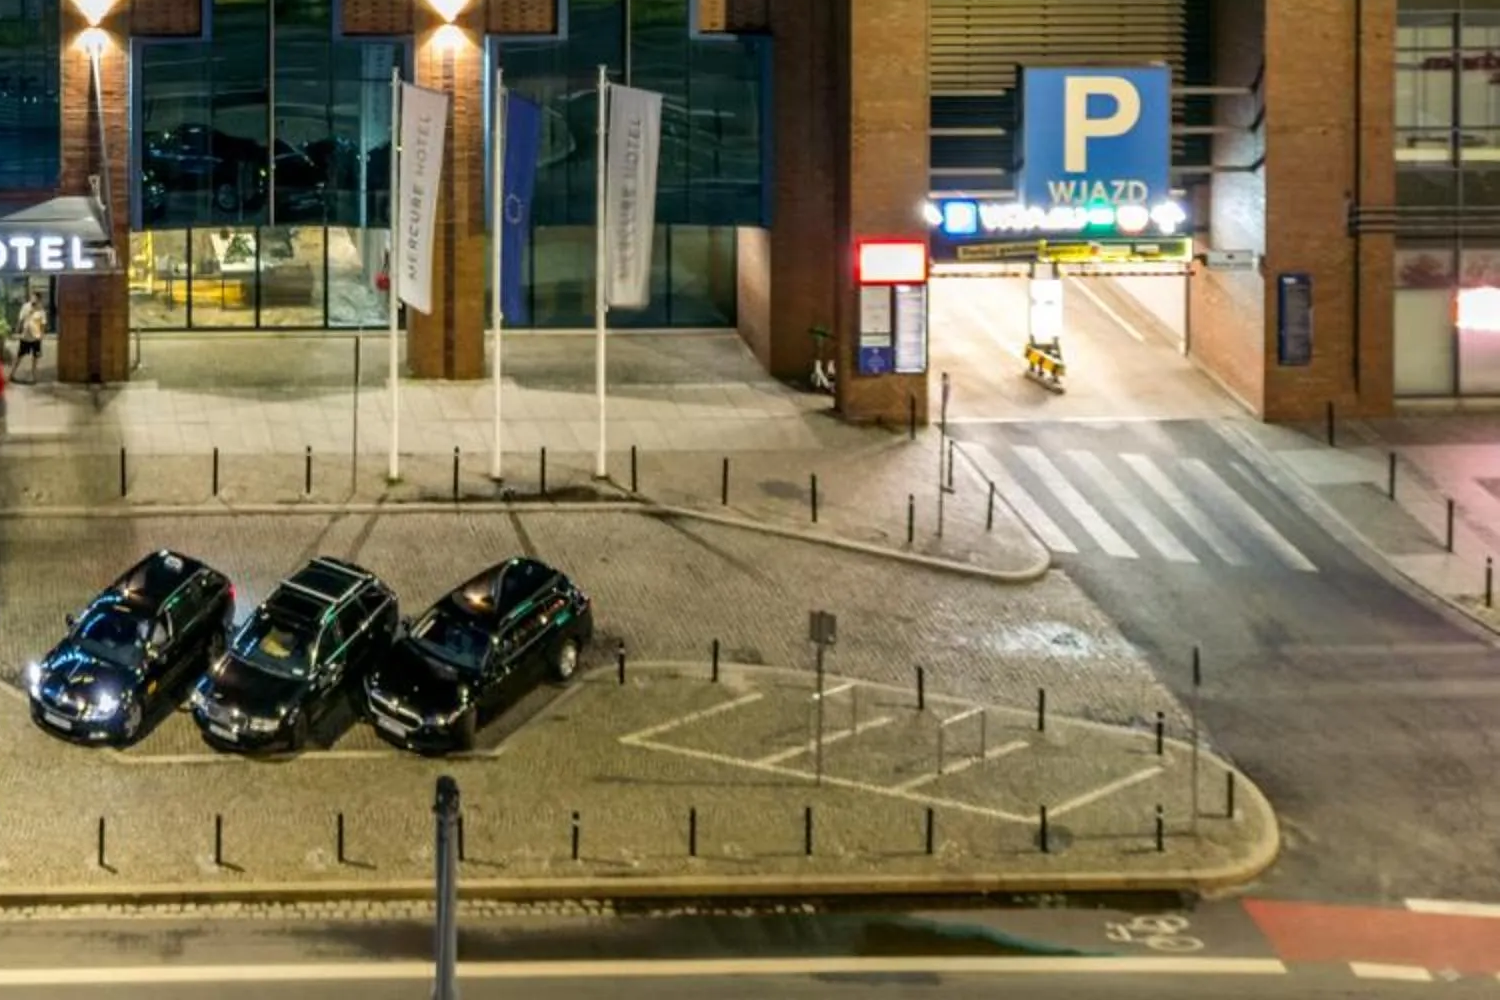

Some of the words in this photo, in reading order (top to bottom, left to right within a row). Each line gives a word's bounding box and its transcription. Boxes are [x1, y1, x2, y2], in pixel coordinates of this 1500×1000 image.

[414, 114, 432, 177] HOTEL
[1064, 75, 1141, 173] P
[1047, 179, 1150, 204] WJAZD
